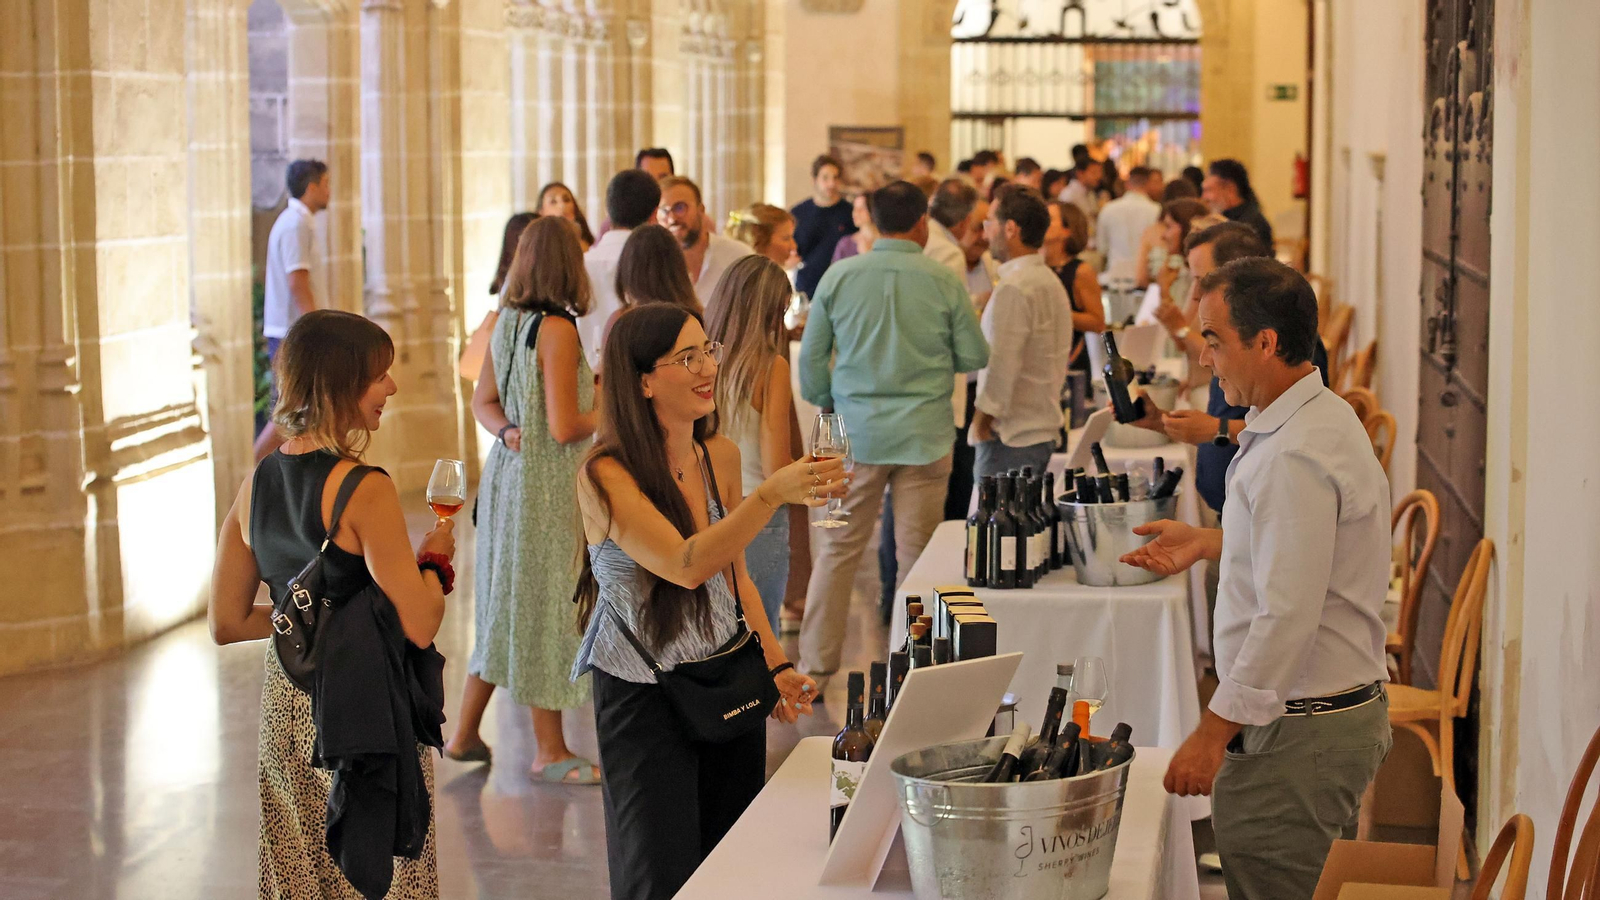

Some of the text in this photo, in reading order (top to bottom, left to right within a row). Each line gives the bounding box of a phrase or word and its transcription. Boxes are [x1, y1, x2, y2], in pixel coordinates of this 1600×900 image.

[723, 708, 741, 720] BIMBA
[745, 699, 760, 709] LOLA
[1041, 831, 1086, 854] VINOS
